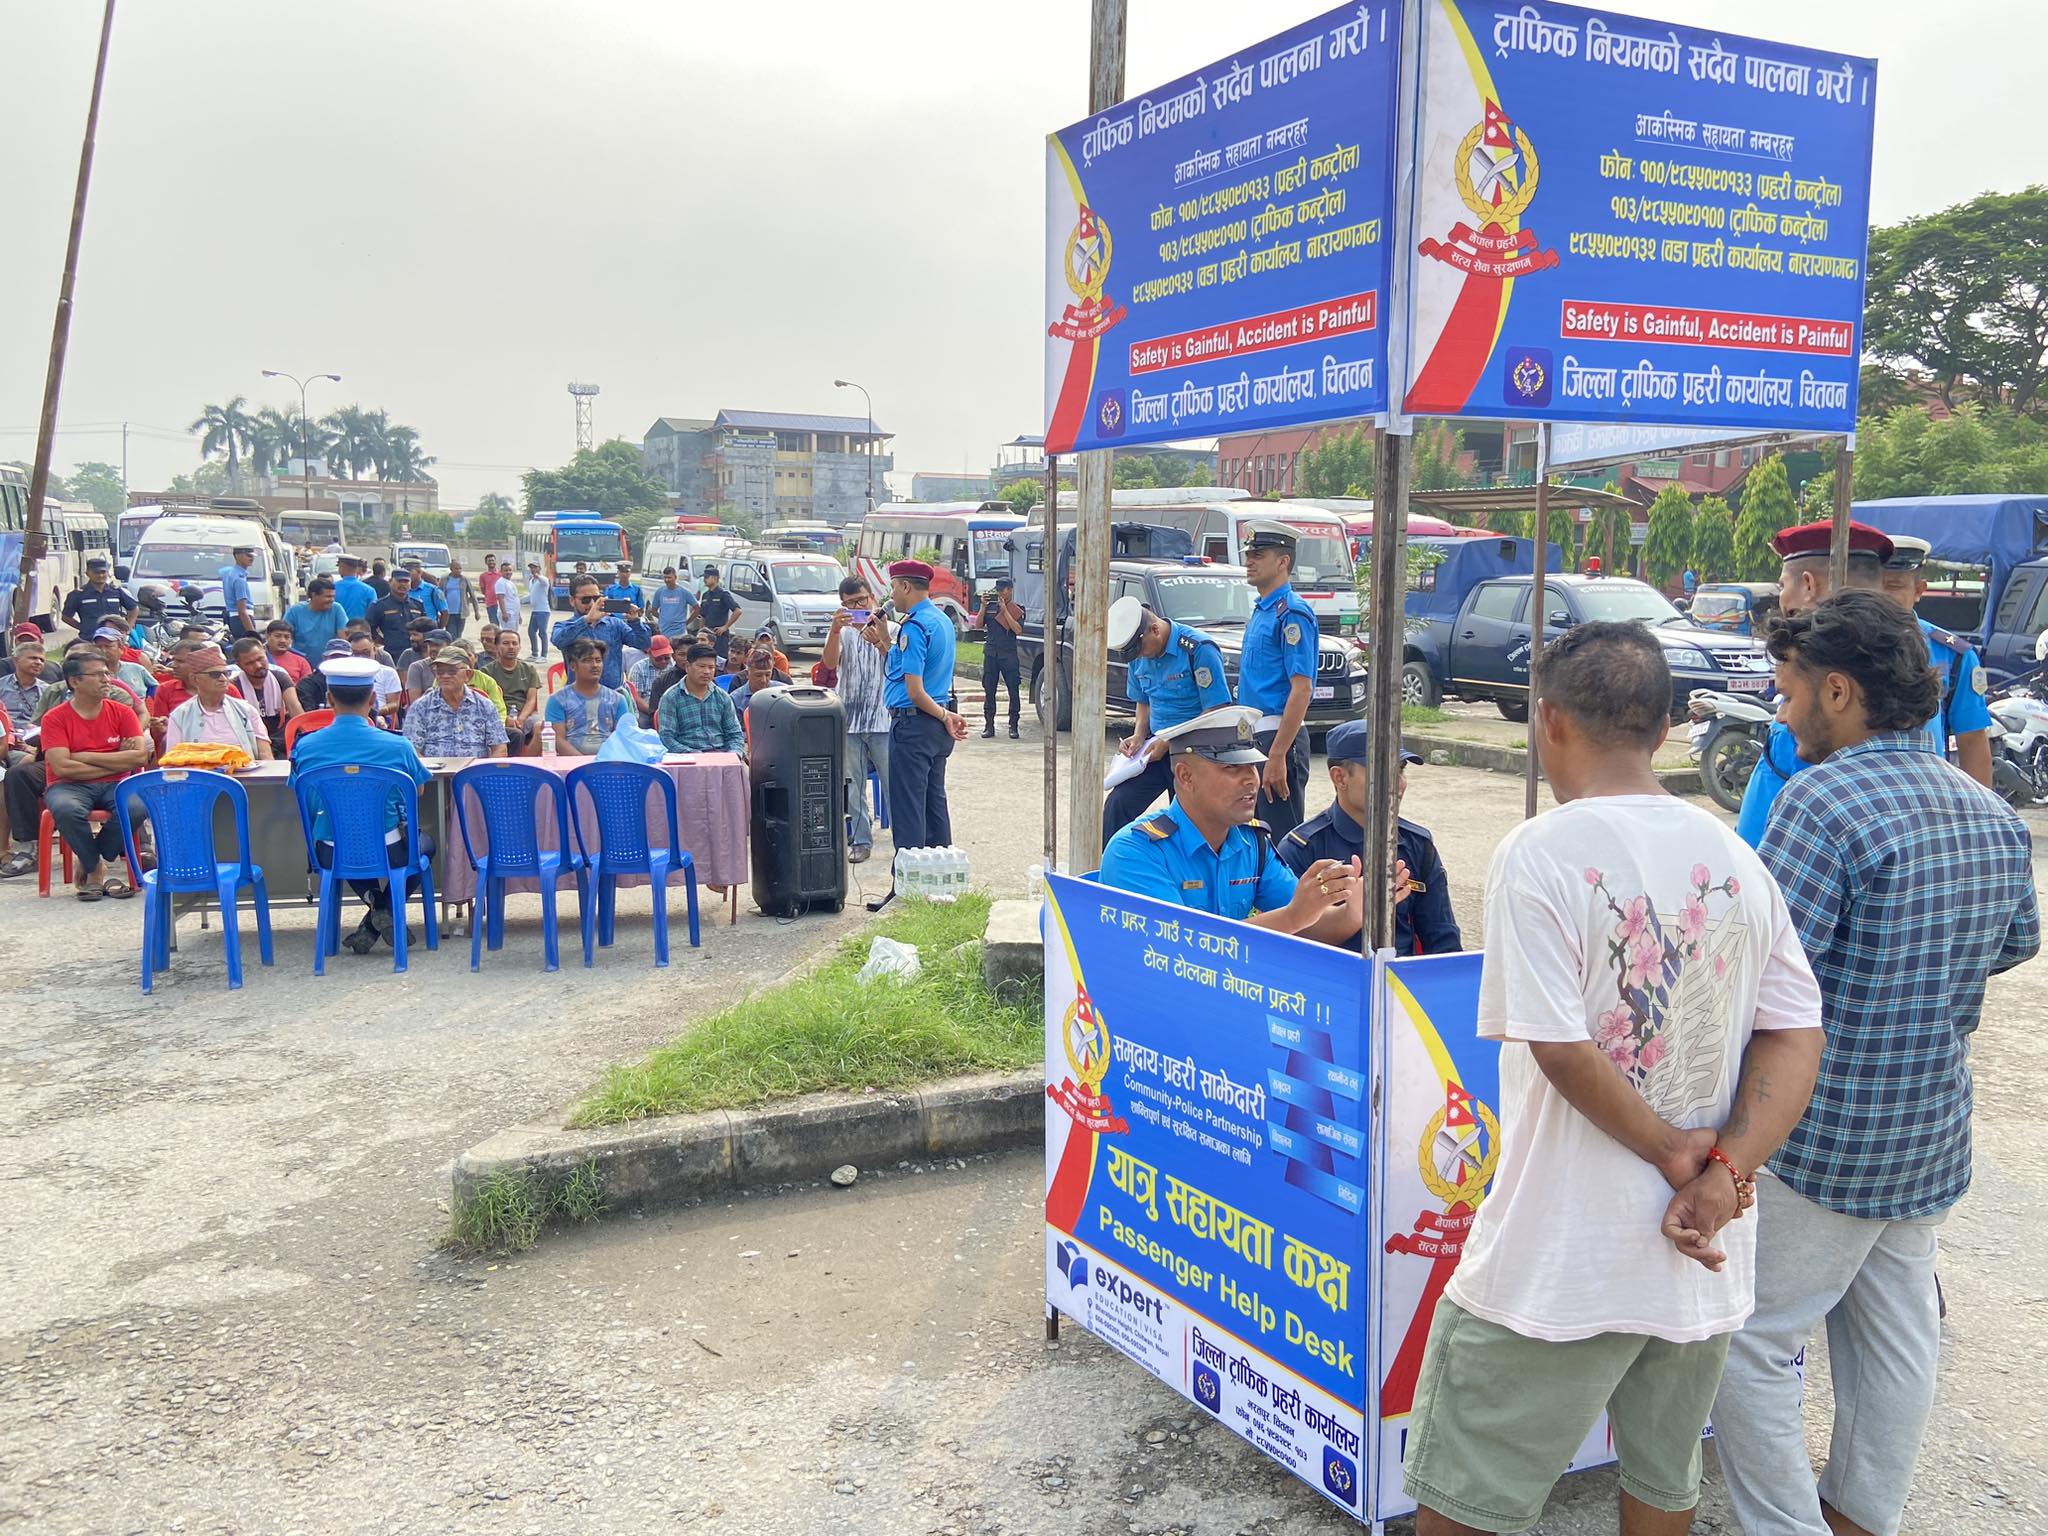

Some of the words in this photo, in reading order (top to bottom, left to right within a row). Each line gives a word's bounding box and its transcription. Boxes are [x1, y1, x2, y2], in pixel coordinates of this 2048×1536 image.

[1493, 5, 1578, 59] ट्राफिक
[1585, 17, 1682, 75] नियमको
[1687, 38, 1737, 86] सदैव
[1744, 56, 1811, 97] पालना
[1082, 114, 1134, 168] ट्राफिक
[1139, 77, 1207, 139] नियमको
[1212, 60, 1254, 111] सदैव
[1260, 35, 1324, 89] पालना
[1635, 110, 1697, 142] आकस्मिक
[1702, 123, 1745, 150] सहायता
[1174, 149, 1221, 184] आकस्मिक
[1225, 135, 1262, 167] सहायता
[1220, 251, 1247, 285] प्रहरी
[1468, 231, 1494, 249] नेपाल
[1496, 235, 1518, 250] प्रहरी
[1473, 258, 1490, 273] सेवा
[1692, 238, 1724, 269] प्रहरी
[1132, 342, 1169, 368] Safety
[1171, 340, 1182, 360] is
[1185, 332, 1233, 354] Gainful,
[1236, 316, 1298, 348] Accident
[1301, 313, 1314, 335] is
[1318, 299, 1372, 331] Painful
[1565, 307, 1618, 339] Safety
[1624, 311, 1638, 335] is
[1643, 312, 1703, 343] Gainful,
[1708, 317, 1777, 344] Accident
[1780, 322, 1794, 345] is
[1797, 324, 1848, 349] Painful
[1131, 389, 1169, 425] जिल्ला
[1171, 380, 1214, 426] ट्राफिक
[1217, 372, 1250, 415] प्रहरी
[1322, 354, 1375, 397] चितवन
[1561, 355, 1616, 398] जिल्ला
[1620, 359, 1678, 407] ट्राफिक
[1682, 365, 1722, 407] प्रहरी
[1799, 370, 1849, 410] चितवन
[1099, 904, 1117, 925] हर
[1154, 919, 1180, 943] गाउँ
[1184, 927, 1194, 948] र
[1198, 931, 1239, 961] नगरी
[1143, 944, 1169, 973] टोल
[1173, 953, 1218, 989] टोलमा
[1222, 967, 1263, 1004] नेपाल
[1268, 988, 1307, 1018] प्रहरी
[1124, 1074, 1203, 1121] Community-Police
[1205, 1108, 1263, 1149] Partnership
[1107, 1143, 1160, 1223] यात्रु
[1165, 1173, 1274, 1271] सहायता
[1283, 1233, 1352, 1313] कक्ष
[1435, 1215, 1460, 1229] नेपाल
[1095, 1266, 1163, 1326] expert
[1095, 1291, 1138, 1328] EDUCATION
[1144, 1323, 1163, 1342] VISA
[1100, 1205, 1213, 1293] Passenger
[1220, 1273, 1276, 1335] Help
[1285, 1311, 1356, 1379] Desk
[1192, 1326, 1227, 1373] जिल्ला
[1229, 1356, 1269, 1399] ट्राफिक
[1271, 1382, 1302, 1421] प्रहरी
[1305, 1403, 1360, 1460] कार्यालय
